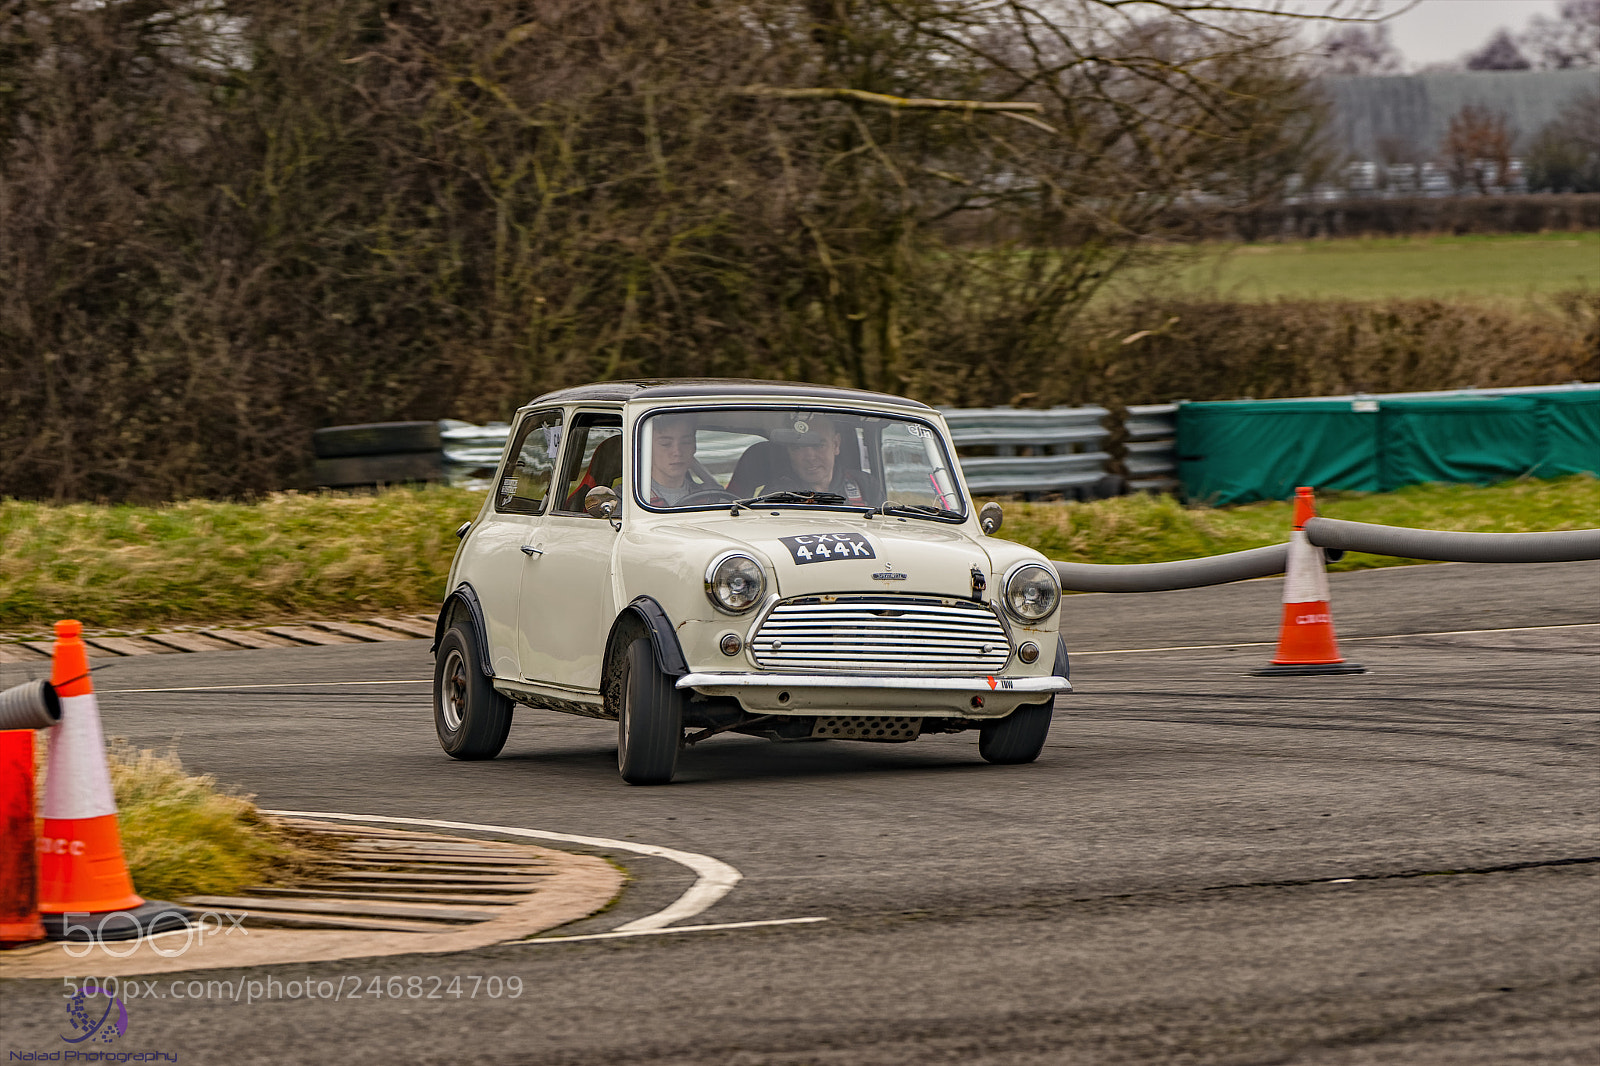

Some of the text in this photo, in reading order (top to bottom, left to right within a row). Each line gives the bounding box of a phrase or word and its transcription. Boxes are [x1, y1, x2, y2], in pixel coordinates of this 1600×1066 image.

[794, 533, 851, 545] CXC
[796, 541, 870, 560] 444K
[884, 561, 893, 571] S
